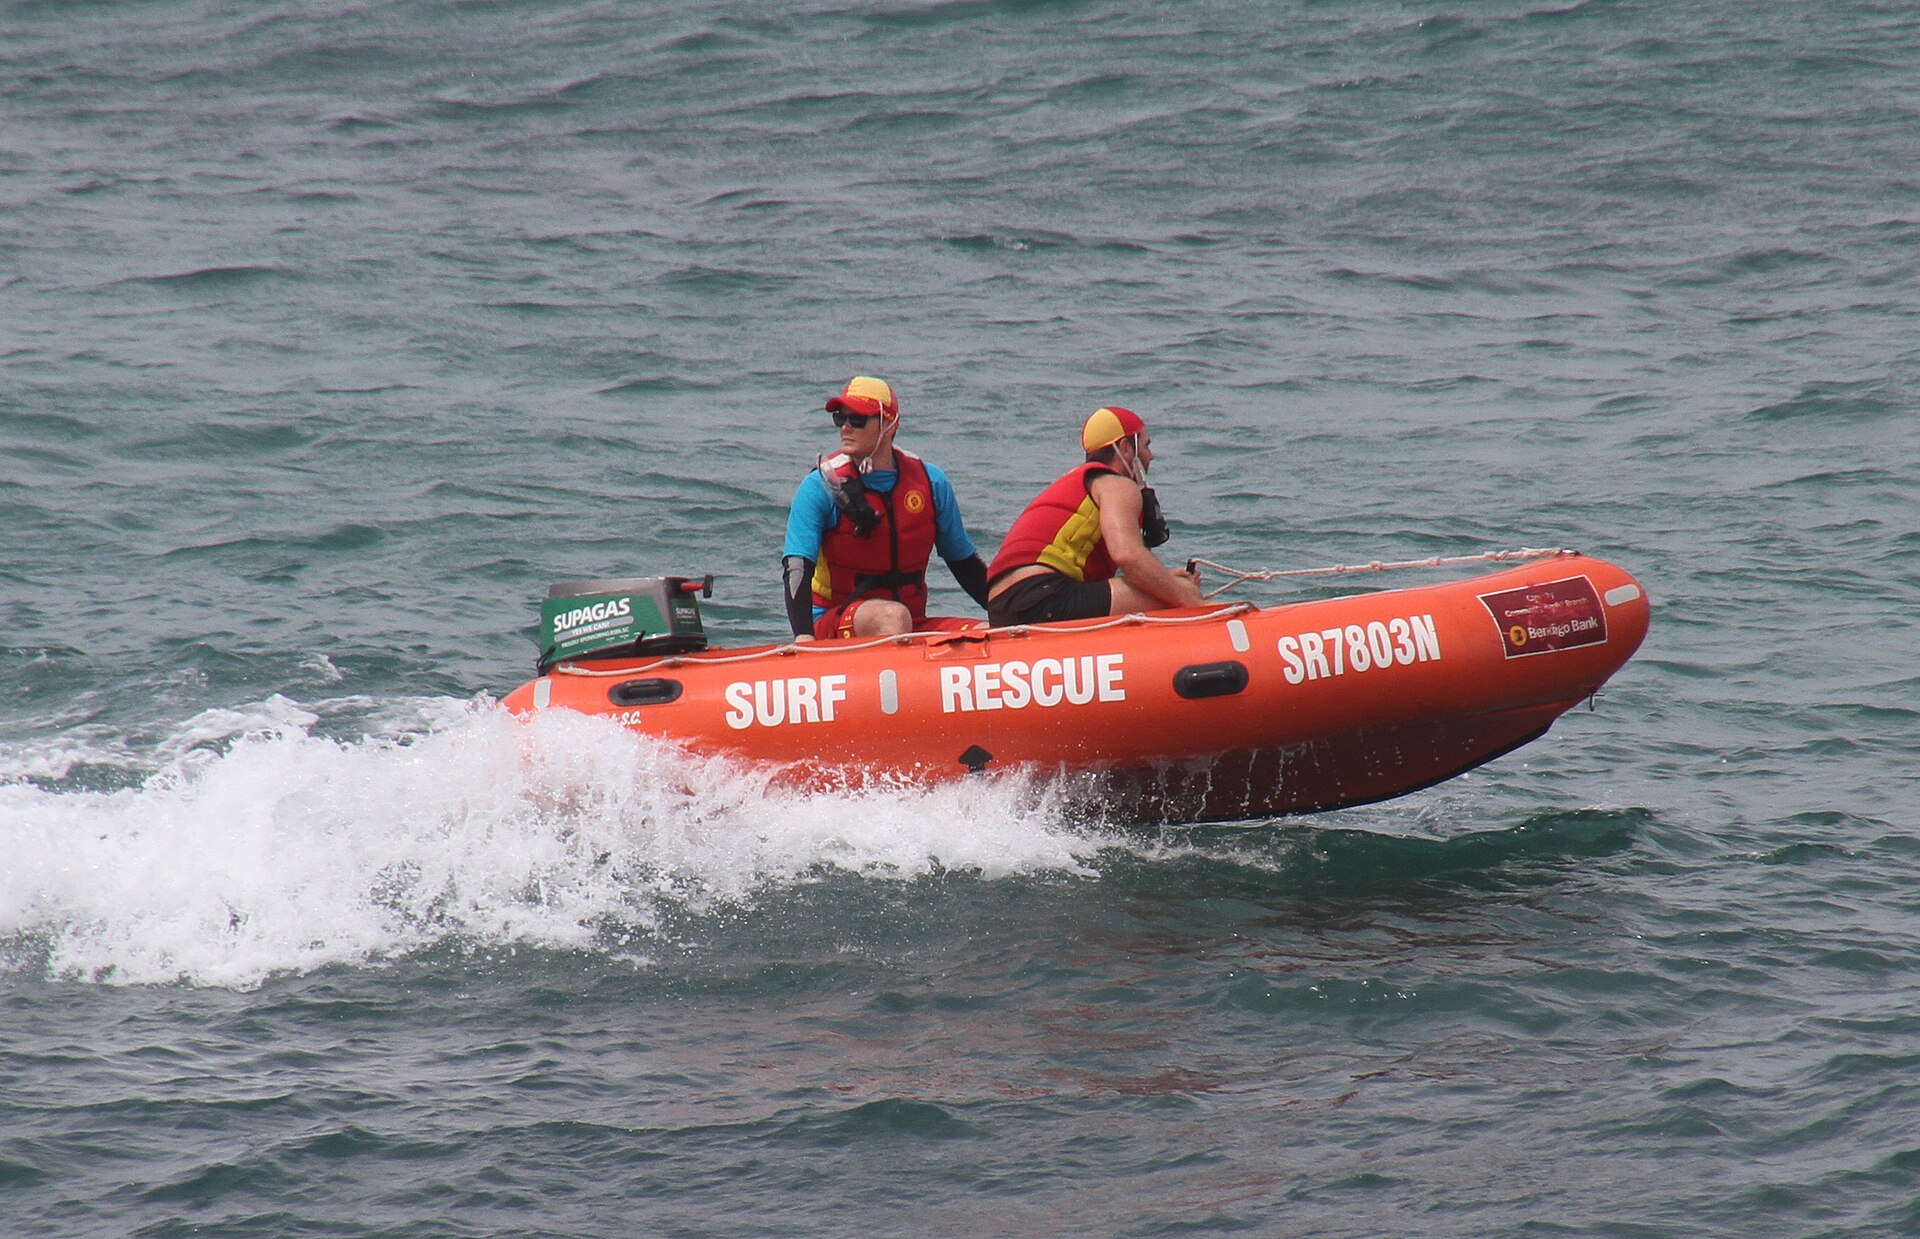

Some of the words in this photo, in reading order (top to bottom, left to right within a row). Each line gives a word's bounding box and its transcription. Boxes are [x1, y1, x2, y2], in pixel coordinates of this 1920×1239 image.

[554, 598, 630, 632] SUPAGAS
[1571, 616, 1599, 632] Bank
[1277, 614, 1441, 685] SR7803N
[725, 674, 847, 730] SURF
[940, 653, 1126, 713] RESCUE
